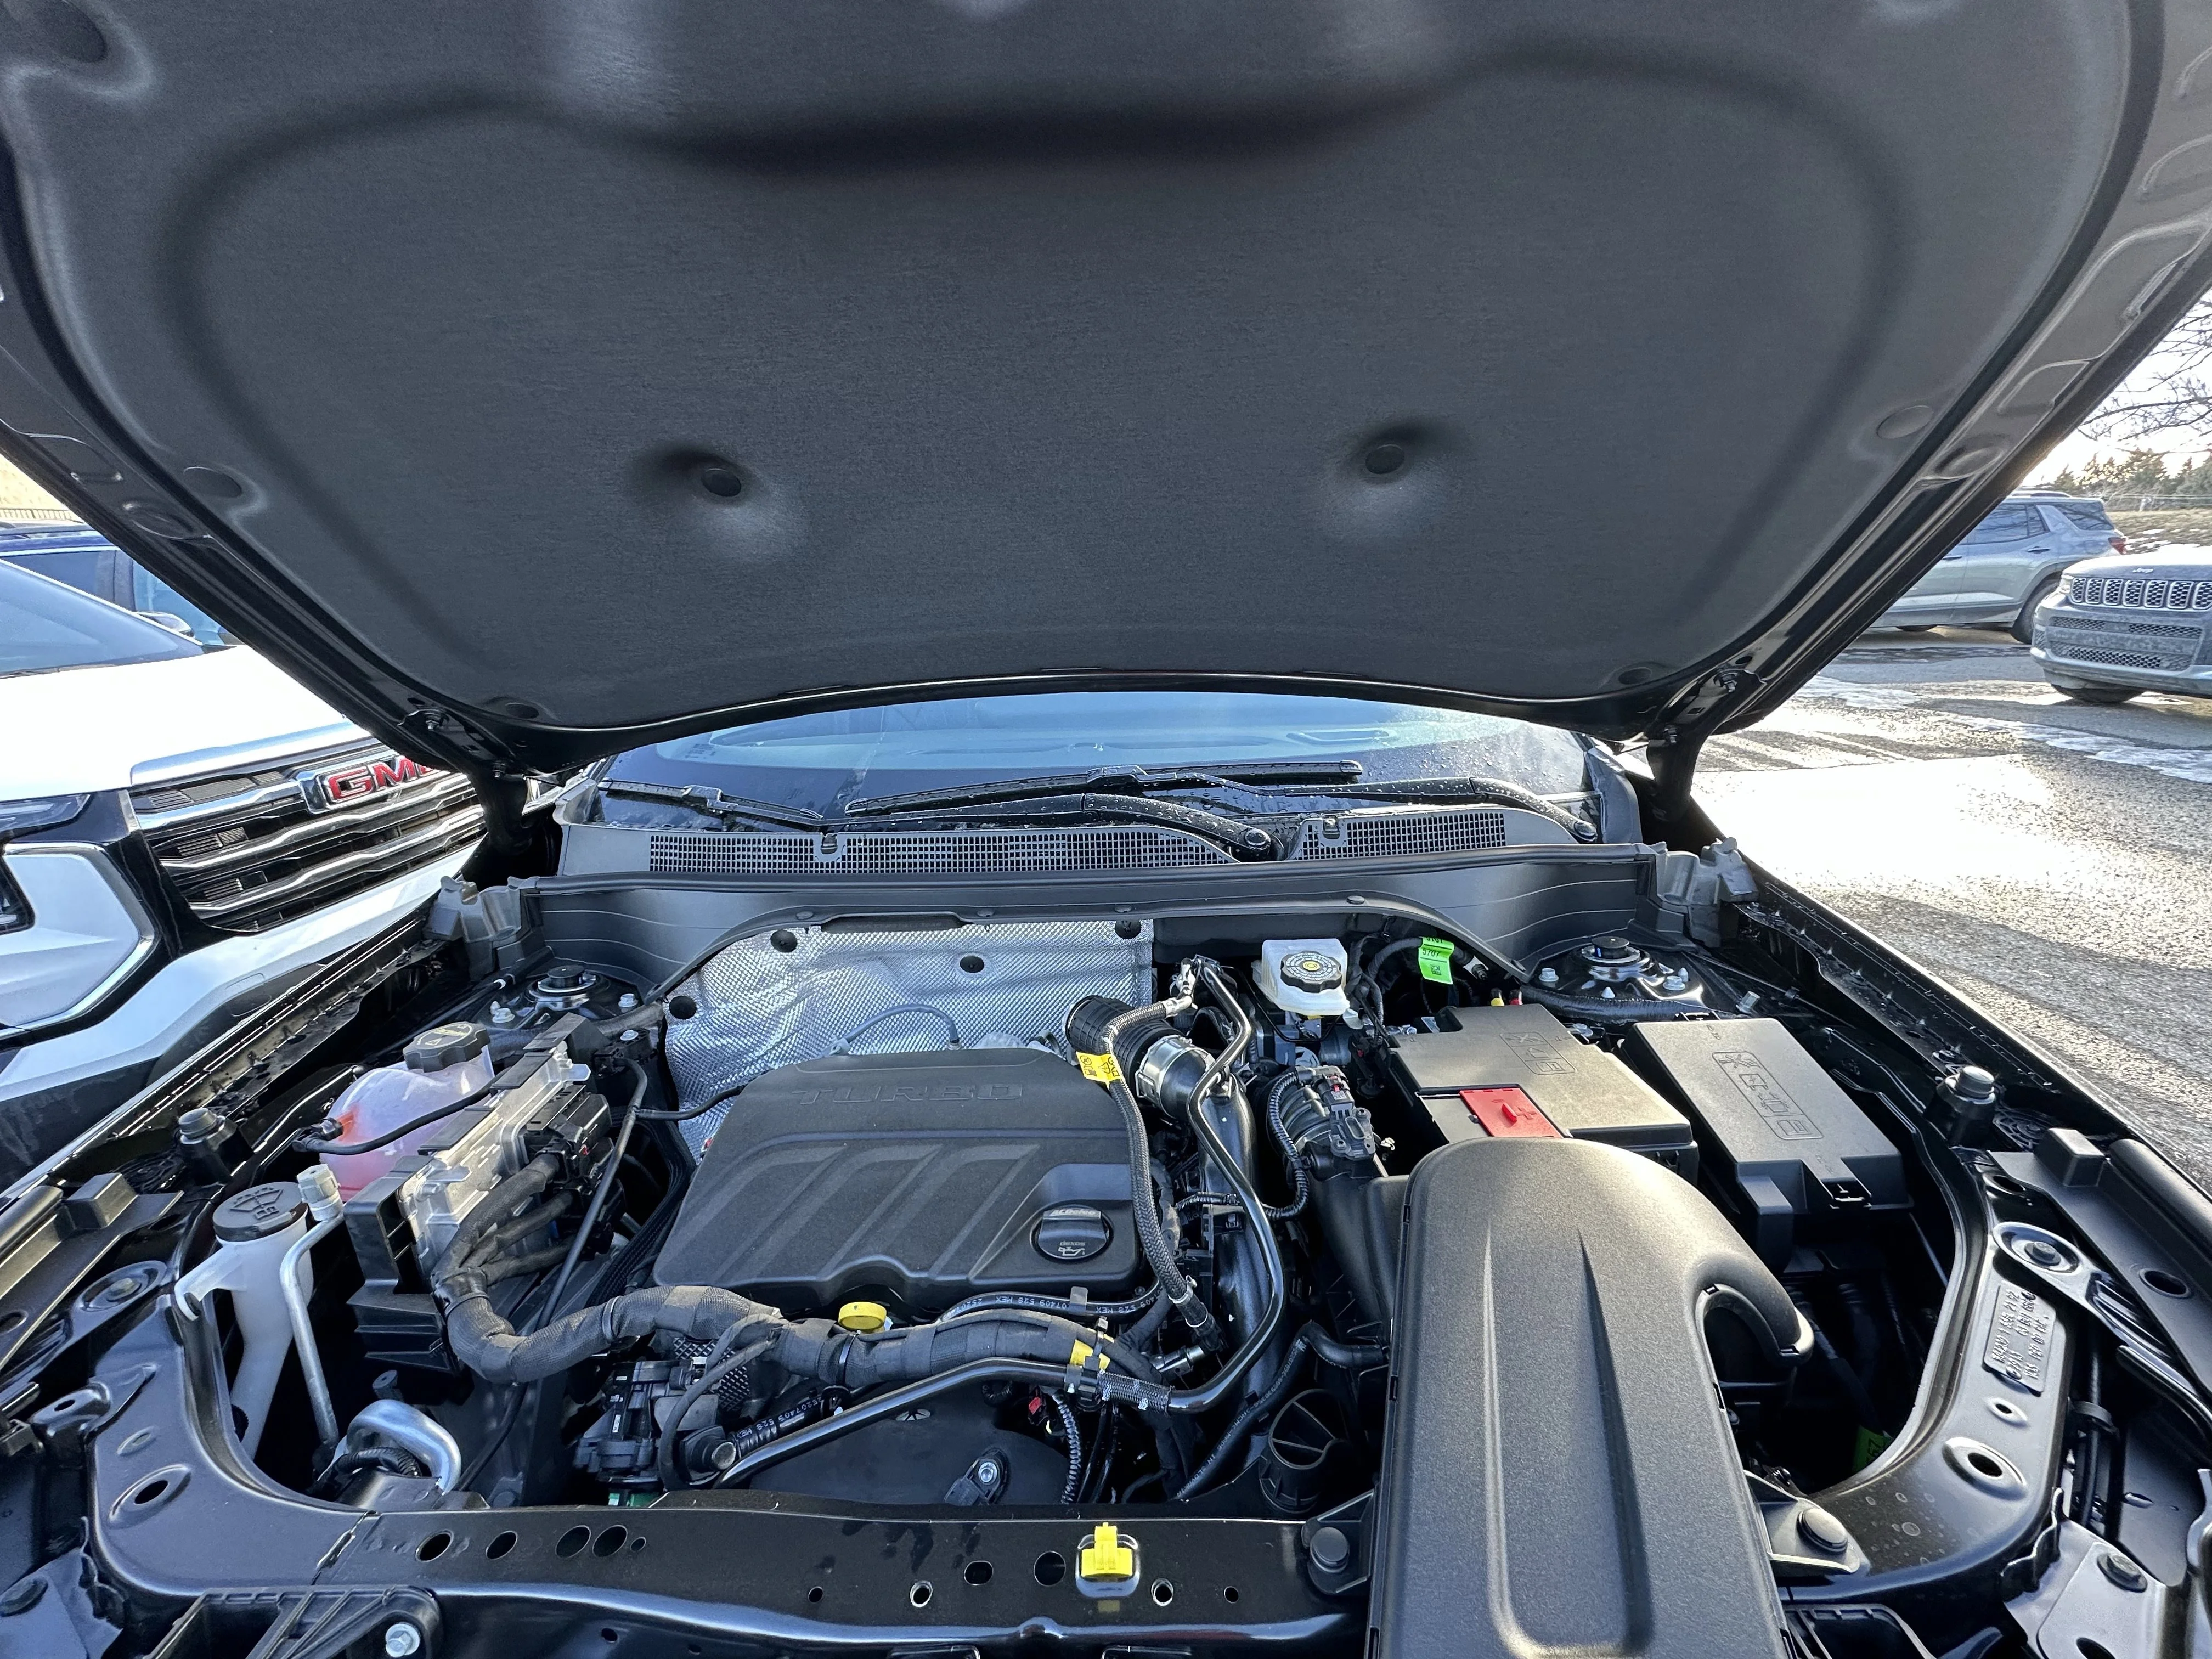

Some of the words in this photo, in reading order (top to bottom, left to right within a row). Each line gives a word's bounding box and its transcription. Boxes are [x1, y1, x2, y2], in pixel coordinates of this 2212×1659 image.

[791, 1084, 1023, 1105] TURBO
[1039, 1300, 1070, 1310] 07409
[1207, 1454, 1215, 1465] IN
